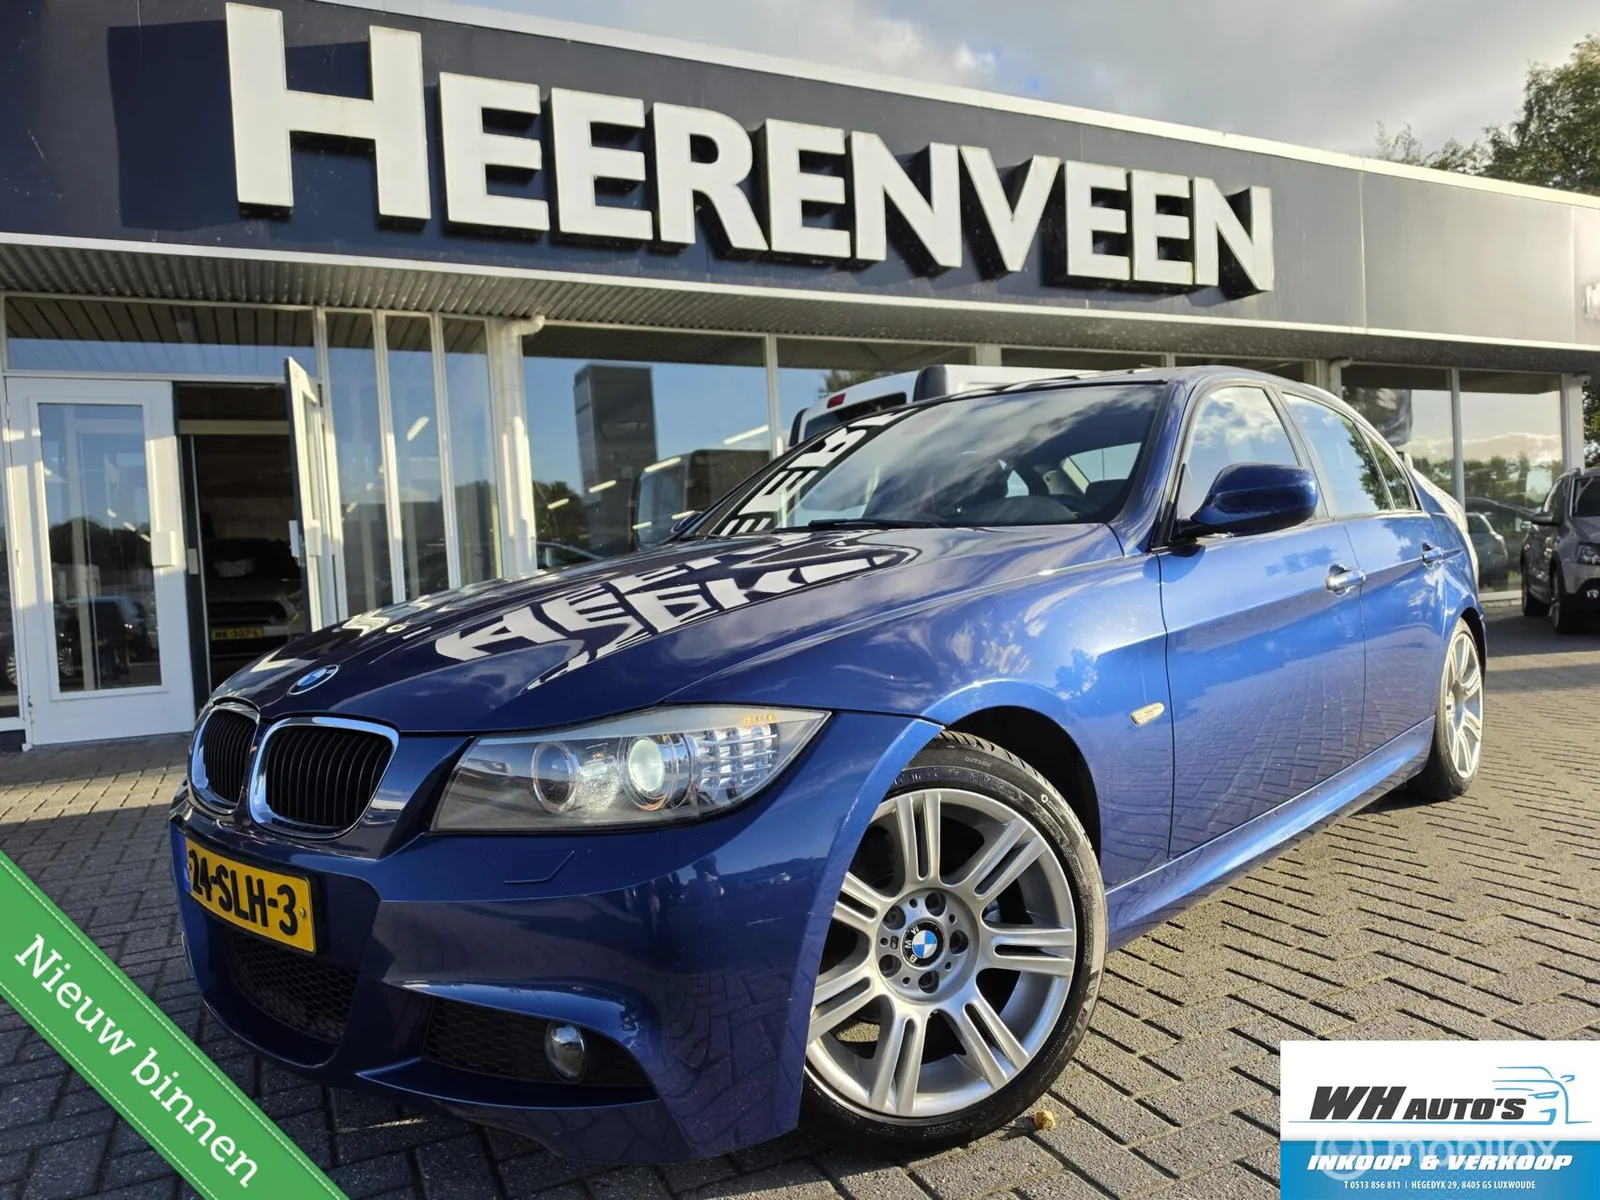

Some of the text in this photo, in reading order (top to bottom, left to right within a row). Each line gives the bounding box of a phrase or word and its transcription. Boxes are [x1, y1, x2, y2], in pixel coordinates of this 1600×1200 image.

[226, 2, 1275, 293] HEERENVEEN
[964, 756, 993, 768] OUTSIDE
[188, 849, 298, 936] 24-SLH-3
